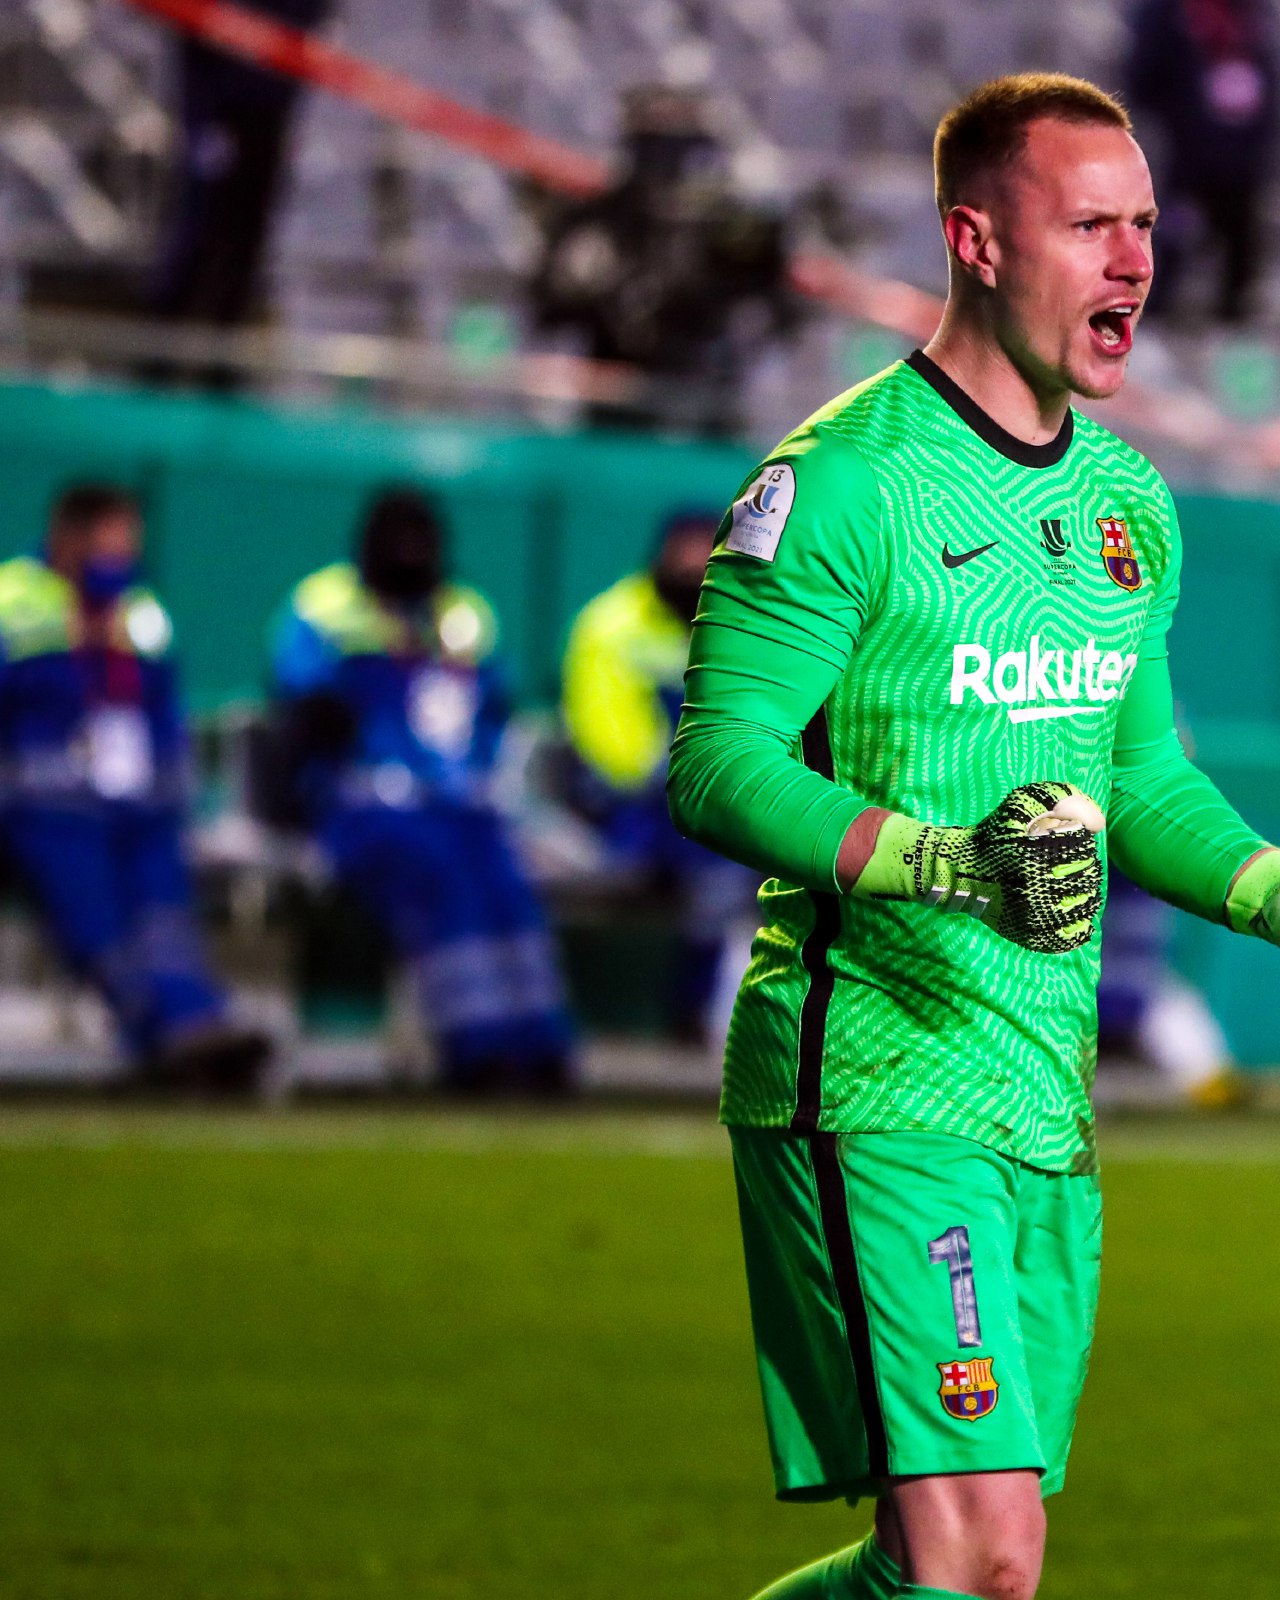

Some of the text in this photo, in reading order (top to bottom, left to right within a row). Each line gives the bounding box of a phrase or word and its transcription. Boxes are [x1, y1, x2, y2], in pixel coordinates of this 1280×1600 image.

[768, 469, 785, 482] 13
[1118, 548, 1131, 557] FCB
[928, 1225, 982, 1348] 1
[957, 1384, 980, 1393] FCB
